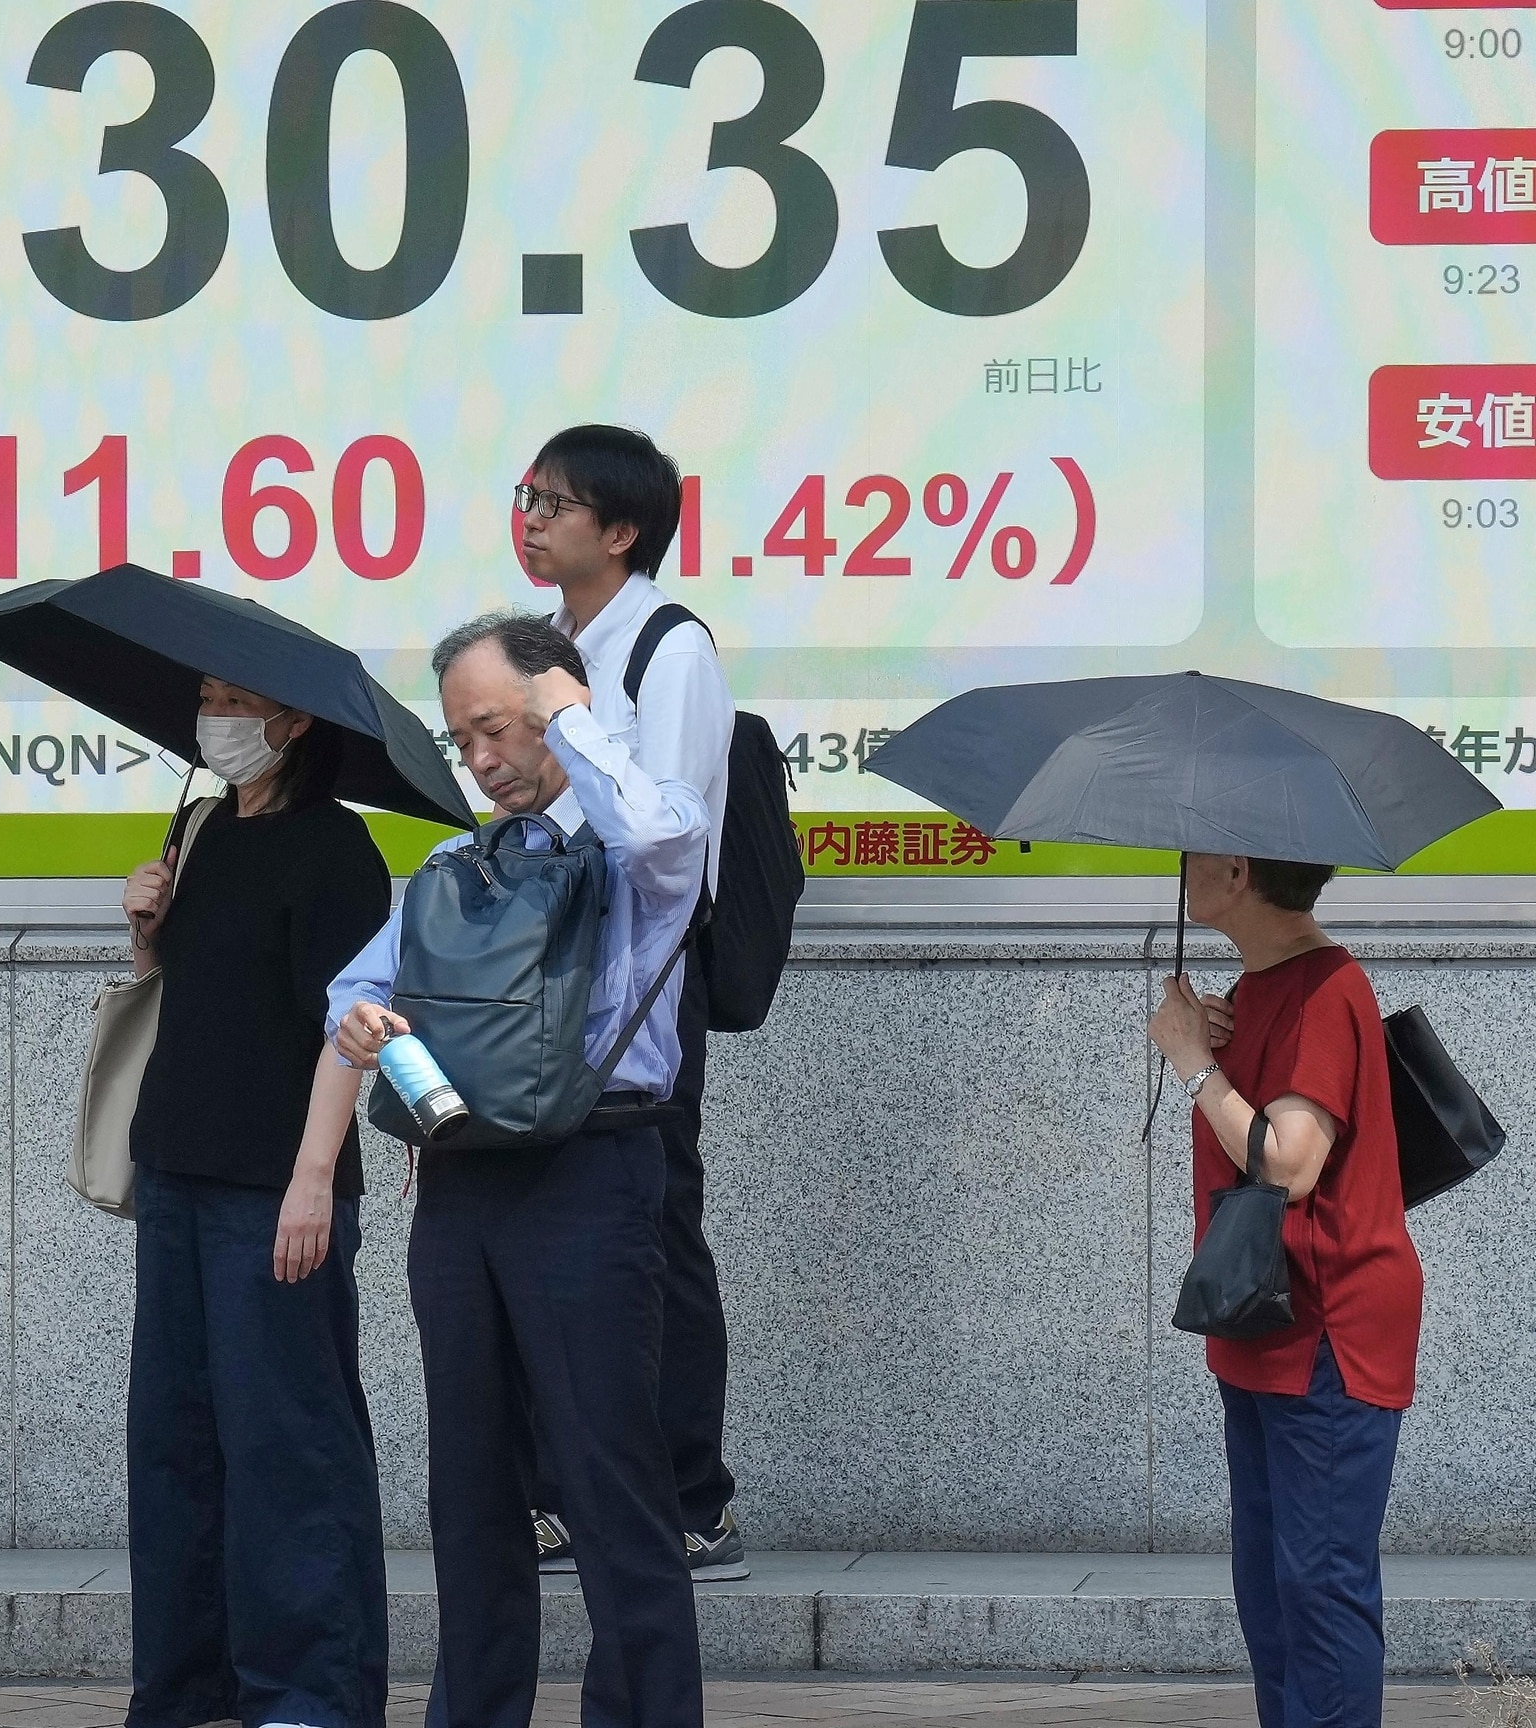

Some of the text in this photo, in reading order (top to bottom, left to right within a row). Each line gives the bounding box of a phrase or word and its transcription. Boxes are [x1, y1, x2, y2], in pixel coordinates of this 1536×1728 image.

[1443, 28, 1523, 59] 9:00
[1417, 156, 1536, 214] 高値
[1442, 264, 1521, 295] 9:23
[983, 356, 1102, 395] 前日比
[1415, 391, 1536, 450] 安値
[1441, 498, 1520, 529] 9:03
[807, 820, 997, 867] 内藤証券
